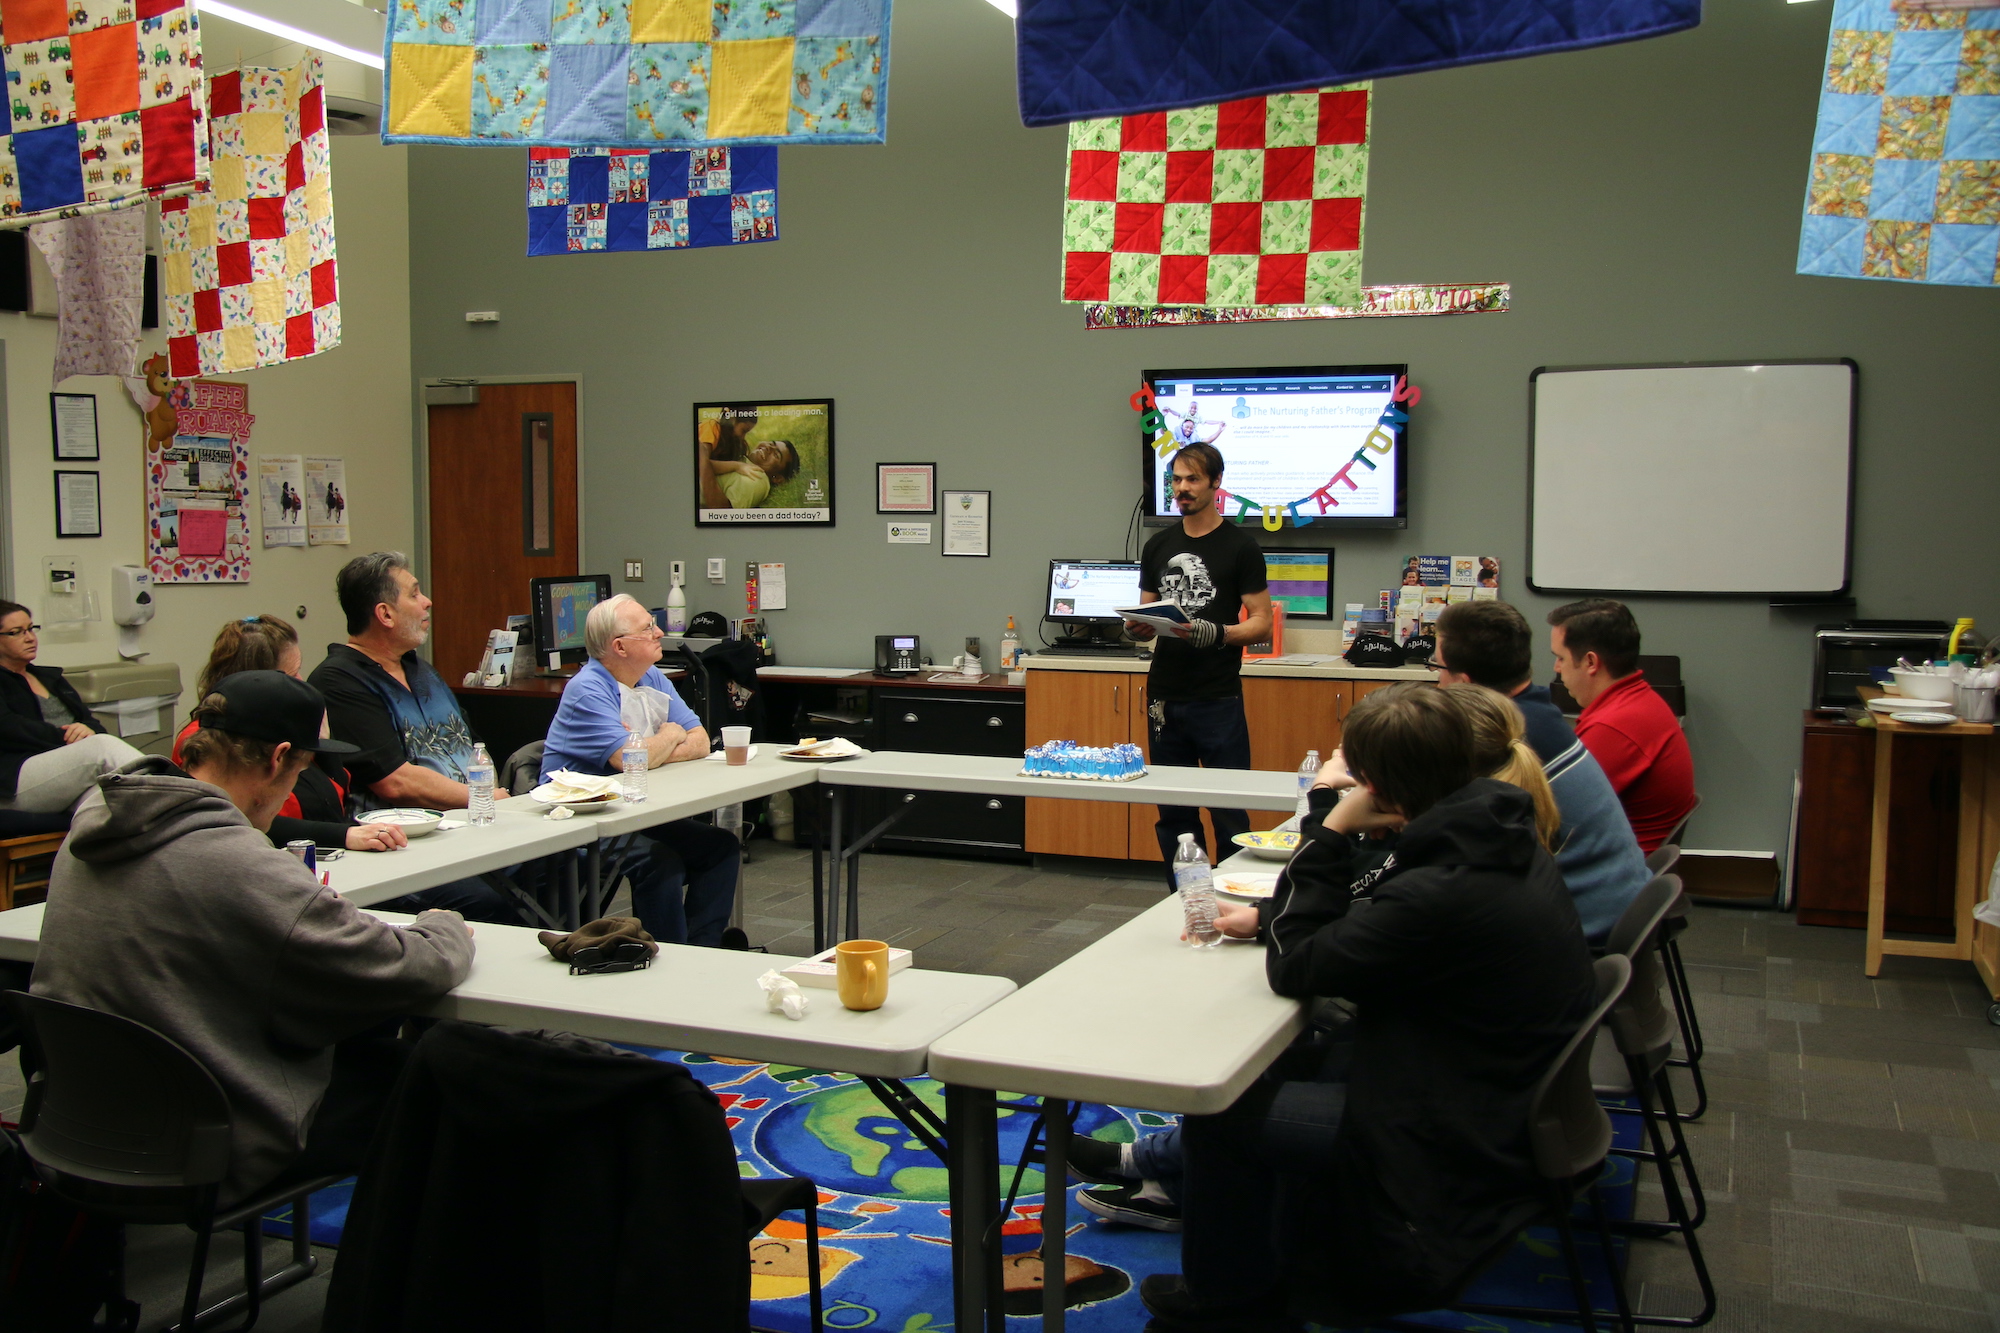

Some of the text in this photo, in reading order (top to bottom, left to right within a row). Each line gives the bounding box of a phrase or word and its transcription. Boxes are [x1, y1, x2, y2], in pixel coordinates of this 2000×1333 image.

[195, 383, 246, 409] FEB
[702, 410, 723, 420] Every
[725, 409, 737, 420] girl
[738, 409, 762, 418] needs
[771, 408, 801, 418] leading
[803, 408, 824, 416] man.
[1253, 406, 1267, 416] The
[1270, 406, 1309, 418] Nurturing
[1346, 405, 1380, 417] Program
[177, 408, 255, 438] RUARY
[200, 449, 233, 457] EFFECTIVE
[200, 456, 233, 464] DISCIPLINE
[708, 512, 728, 520] Have
[730, 513, 745, 522] you
[746, 512, 767, 520] been
[775, 511, 792, 520] dad
[793, 511, 821, 522] today?
[1421, 558, 1436, 566] Help
[551, 585, 590, 598] GOODNIGHT
[575, 600, 595, 611] MOON
[1349, 853, 1398, 896] WASH
